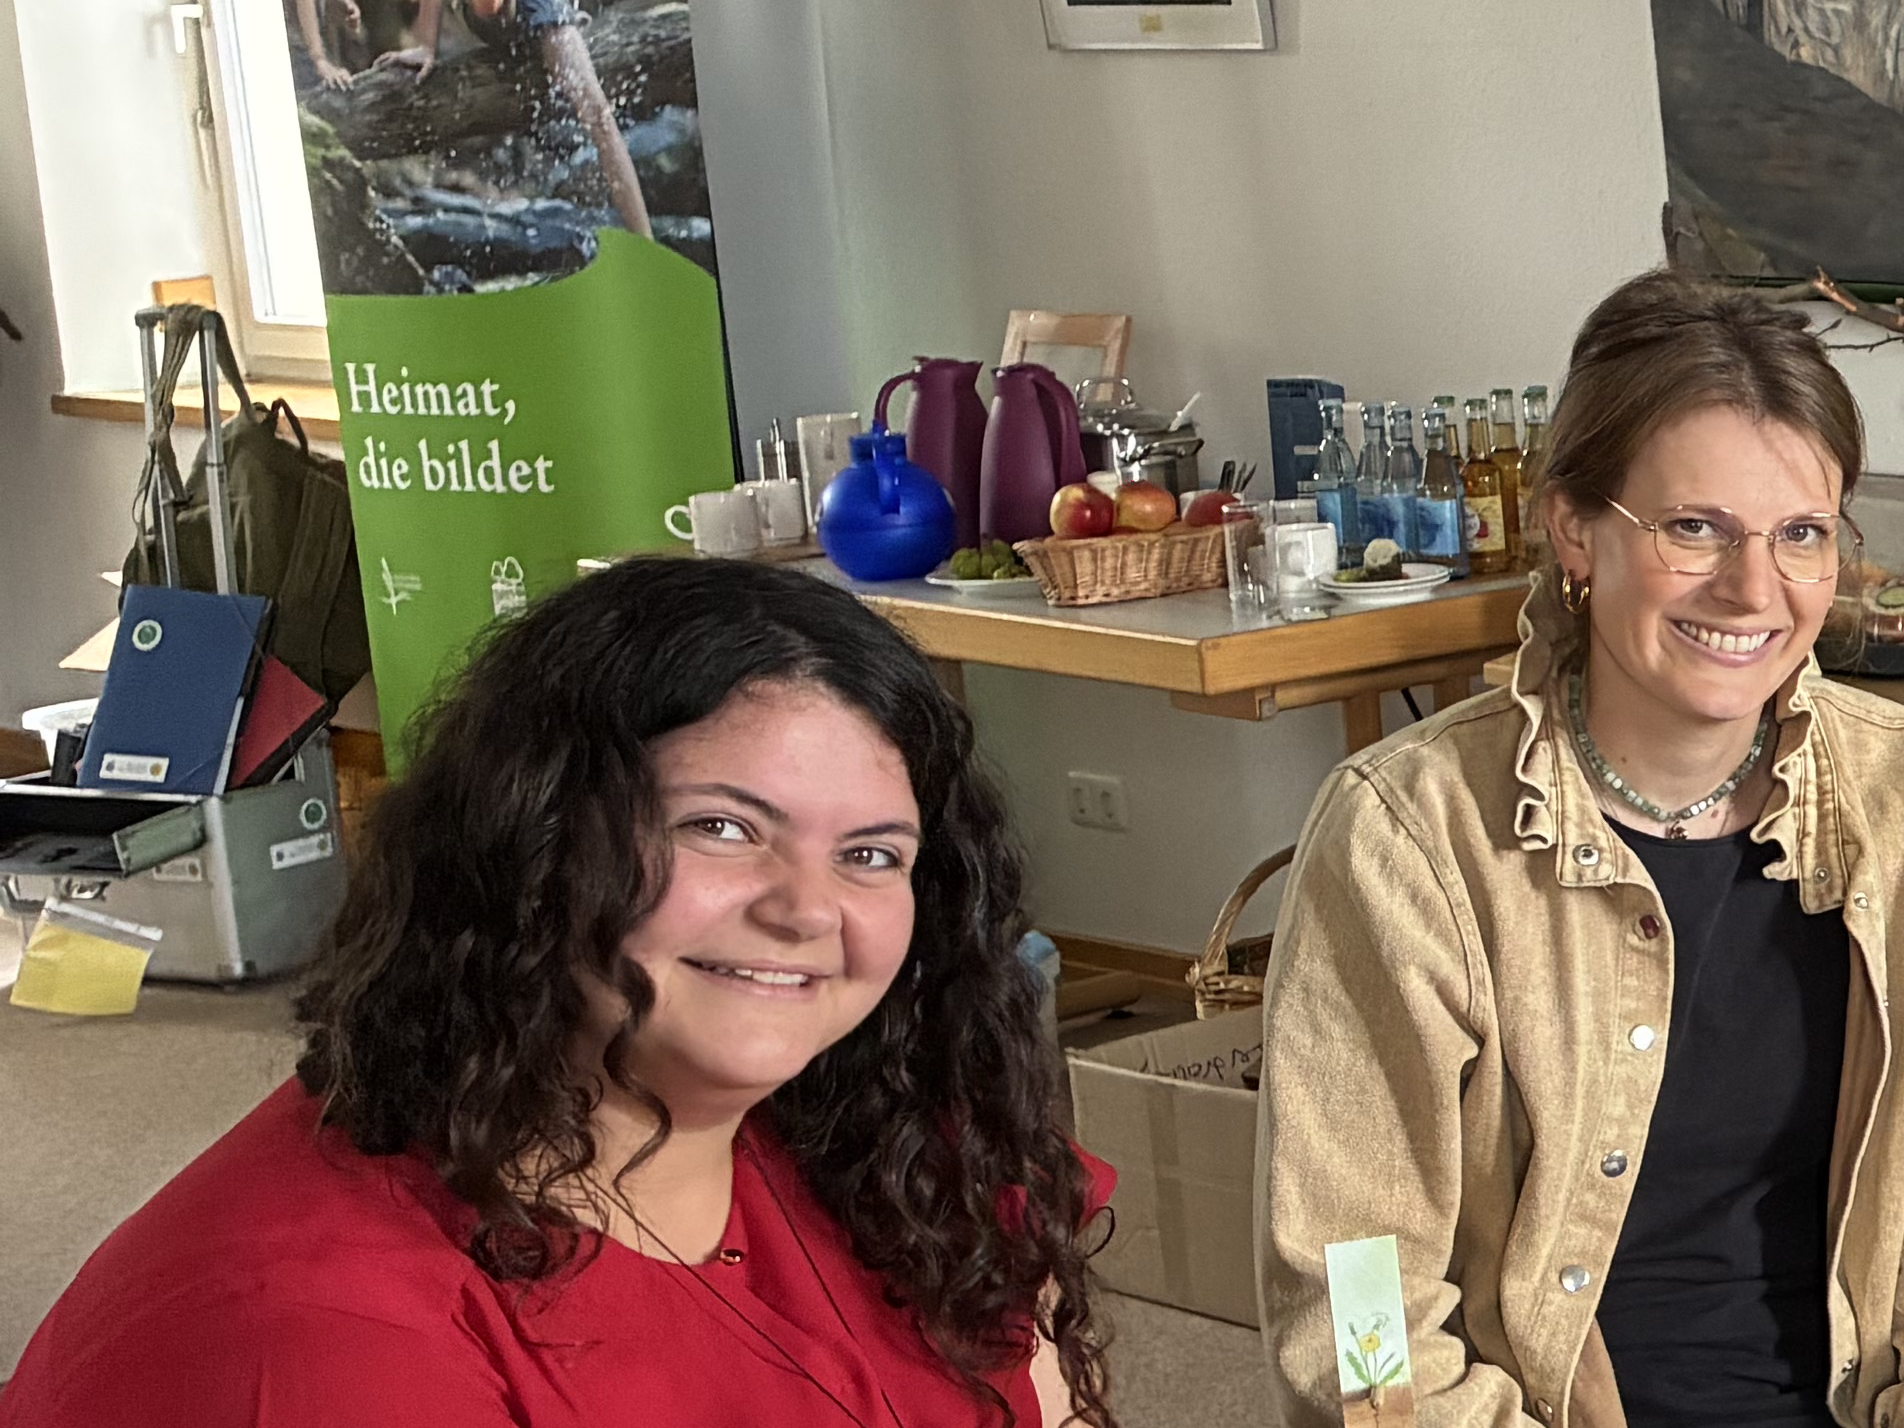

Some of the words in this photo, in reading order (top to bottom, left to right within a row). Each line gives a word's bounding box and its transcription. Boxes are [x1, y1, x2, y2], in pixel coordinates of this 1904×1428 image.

[344, 362, 517, 426] Heimat,
[358, 436, 412, 490] die
[418, 437, 555, 494] bildet
